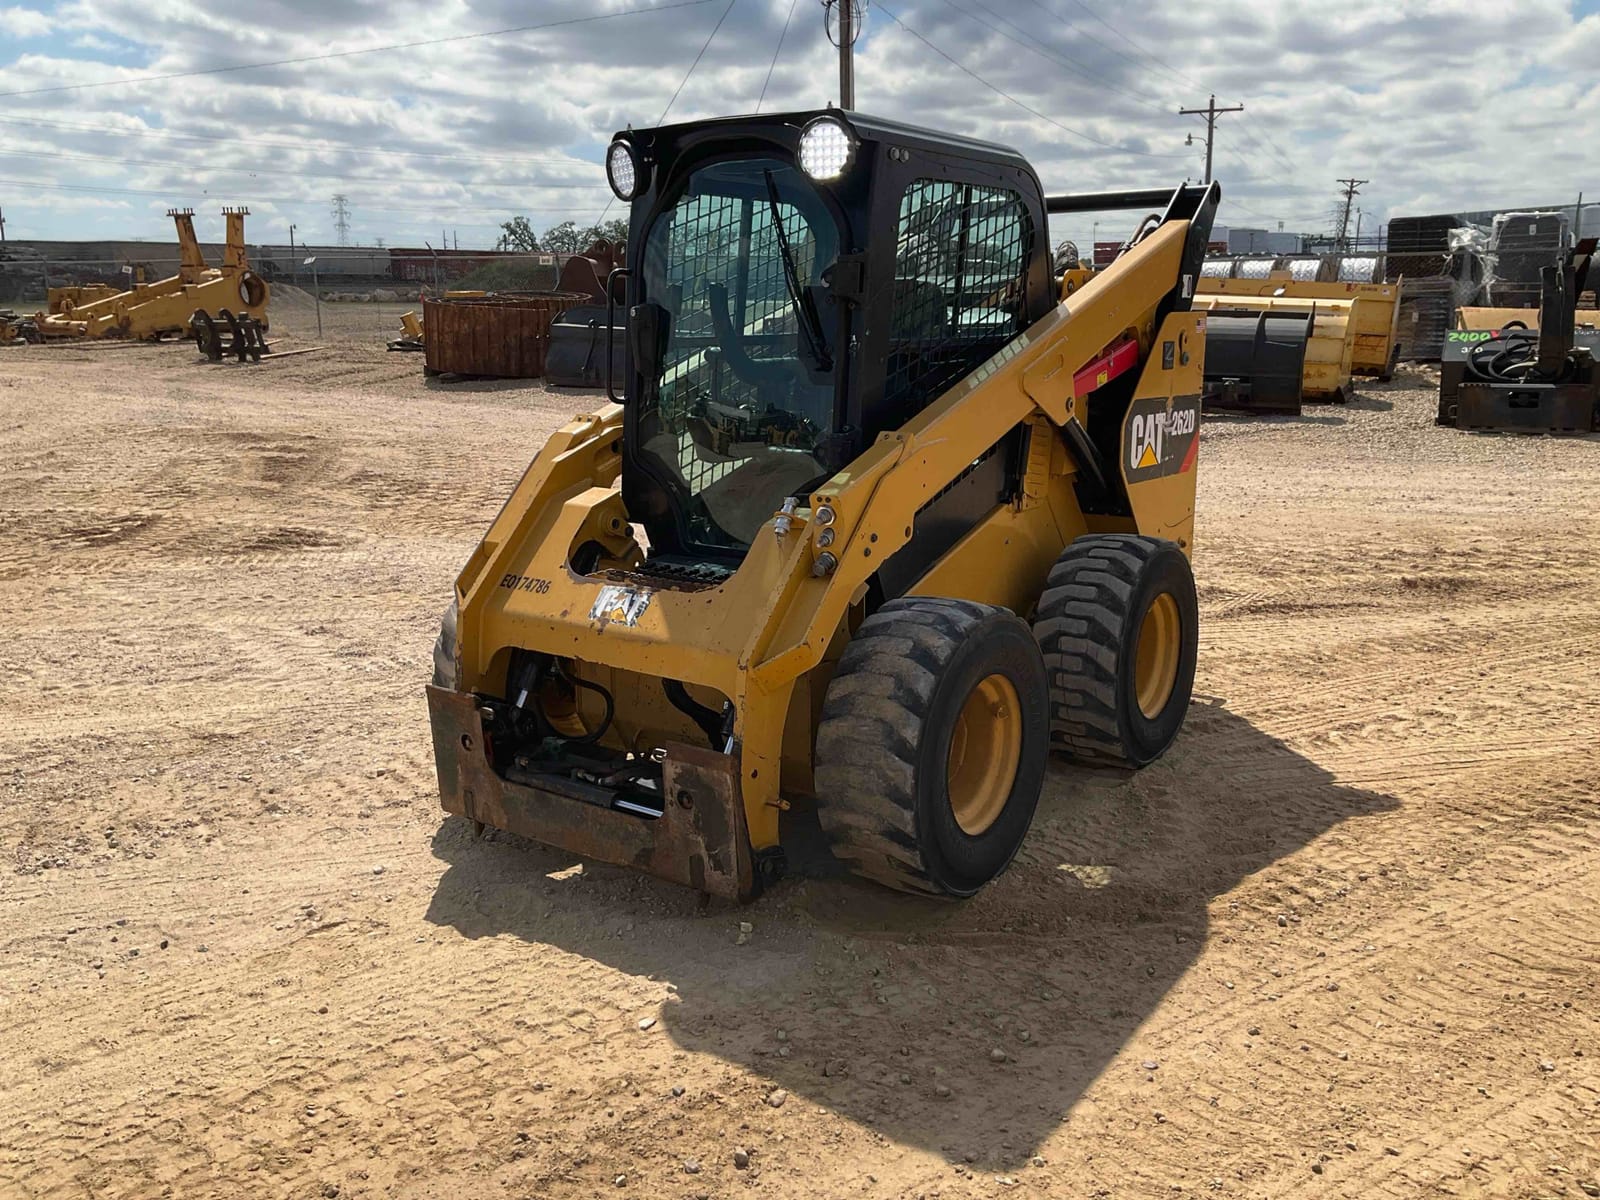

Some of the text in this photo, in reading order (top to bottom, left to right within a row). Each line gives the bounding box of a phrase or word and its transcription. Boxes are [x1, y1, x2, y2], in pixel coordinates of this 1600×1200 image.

[1448, 331, 1491, 342] 2400
[1130, 409, 1195, 469] CAT 262D
